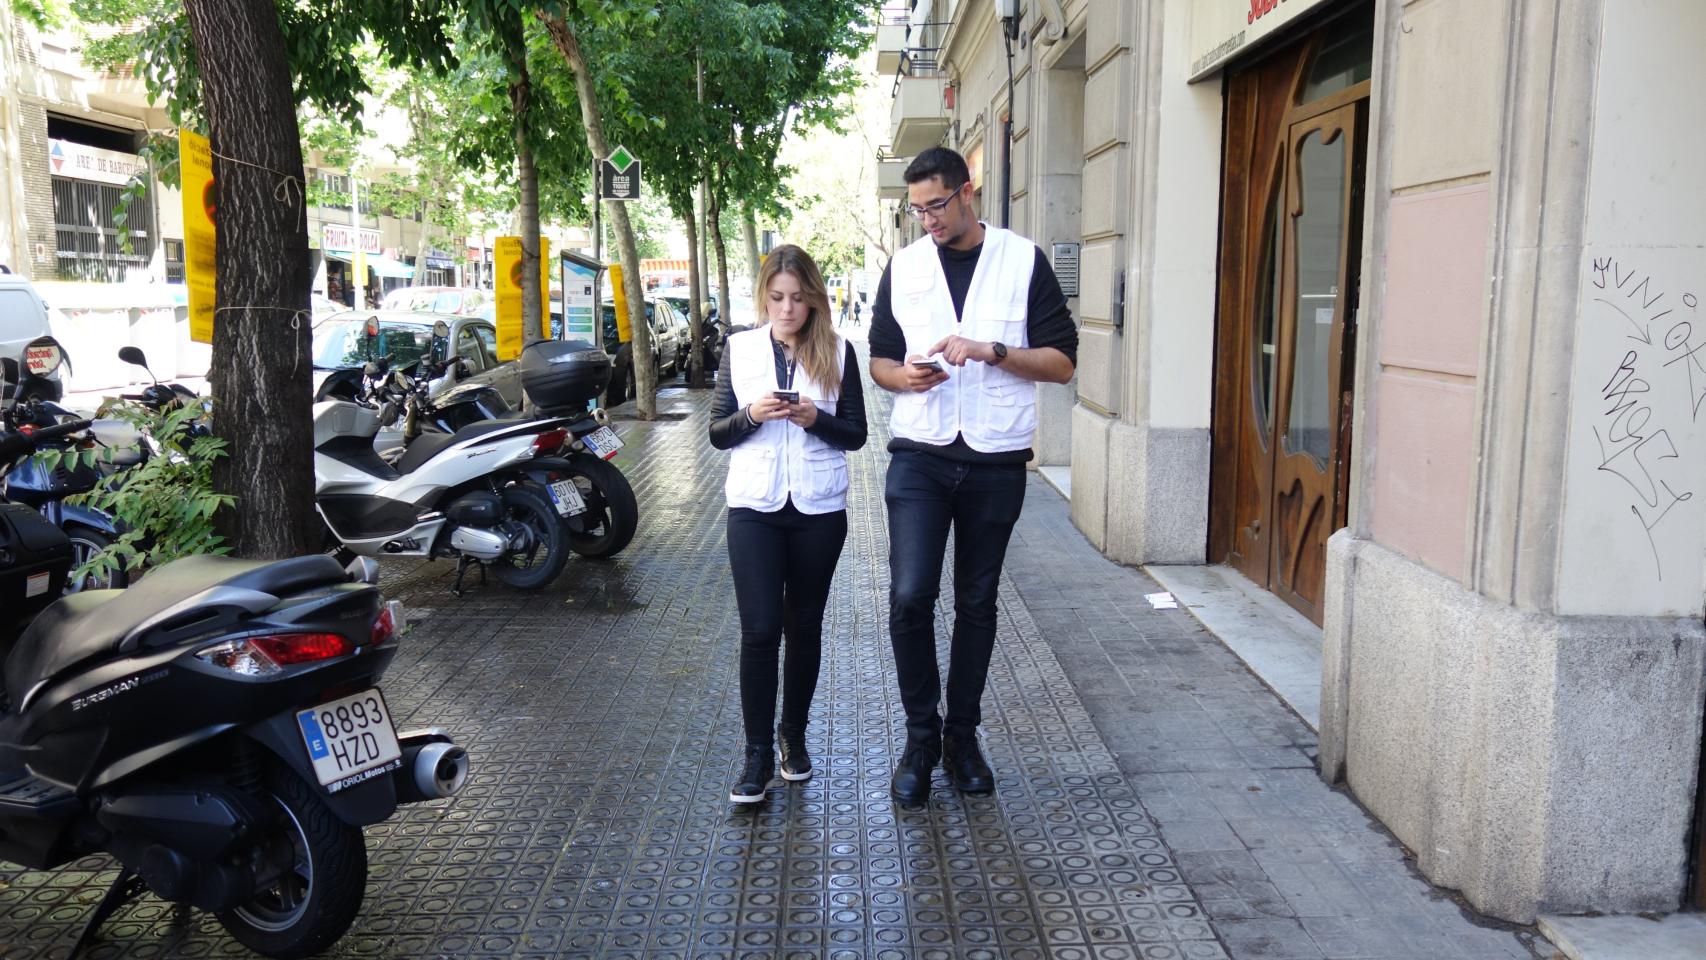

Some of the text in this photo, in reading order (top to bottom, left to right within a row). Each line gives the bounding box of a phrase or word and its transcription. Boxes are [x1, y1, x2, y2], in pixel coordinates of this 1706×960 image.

[97, 158, 107, 173] DE
[325, 229, 348, 248] FRUITA
[72, 677, 139, 711] BURGMAN
[320, 697, 382, 739] 8893
[311, 739, 323, 751] E
[331, 731, 380, 772] HZD
